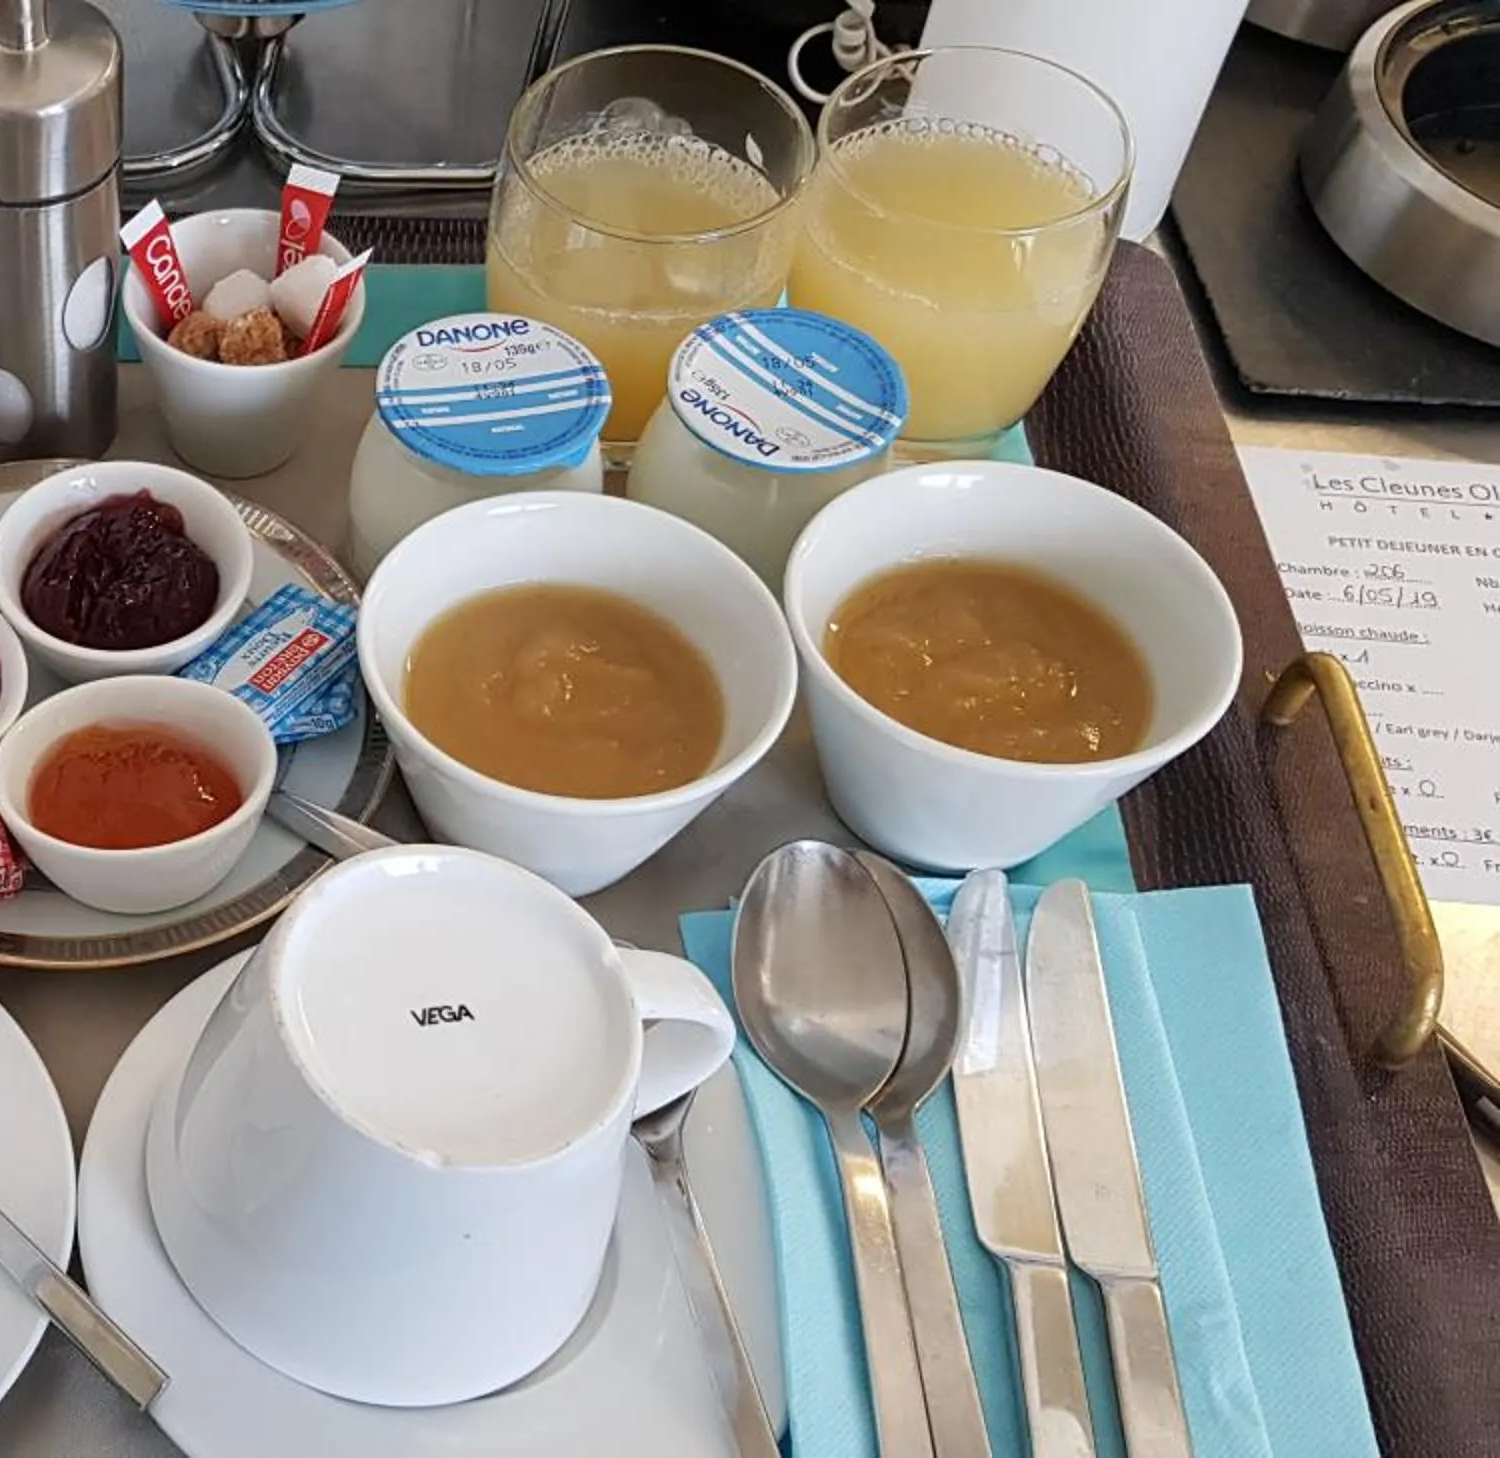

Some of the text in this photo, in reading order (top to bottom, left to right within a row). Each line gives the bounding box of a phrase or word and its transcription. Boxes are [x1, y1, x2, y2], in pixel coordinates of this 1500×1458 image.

[416, 319, 529, 347] DANONE
[461, 358, 518, 374] 18/05
[679, 388, 780, 457] DANONE
[1312, 474, 1355, 491] Les
[1358, 477, 1464, 499] Cleunes
[1328, 535, 1372, 549] PETIT
[1376, 539, 1462, 556] DEJEUNER
[1465, 546, 1489, 558] EN
[1277, 562, 1350, 577] Chambre
[1298, 622, 1355, 638] oisson
[1359, 626, 1420, 642] chaude
[1354, 679, 1403, 692] ccino
[1385, 723, 1414, 735] Earl
[1417, 728, 1449, 741] grey
[408, 1003, 476, 1027] VEGA
